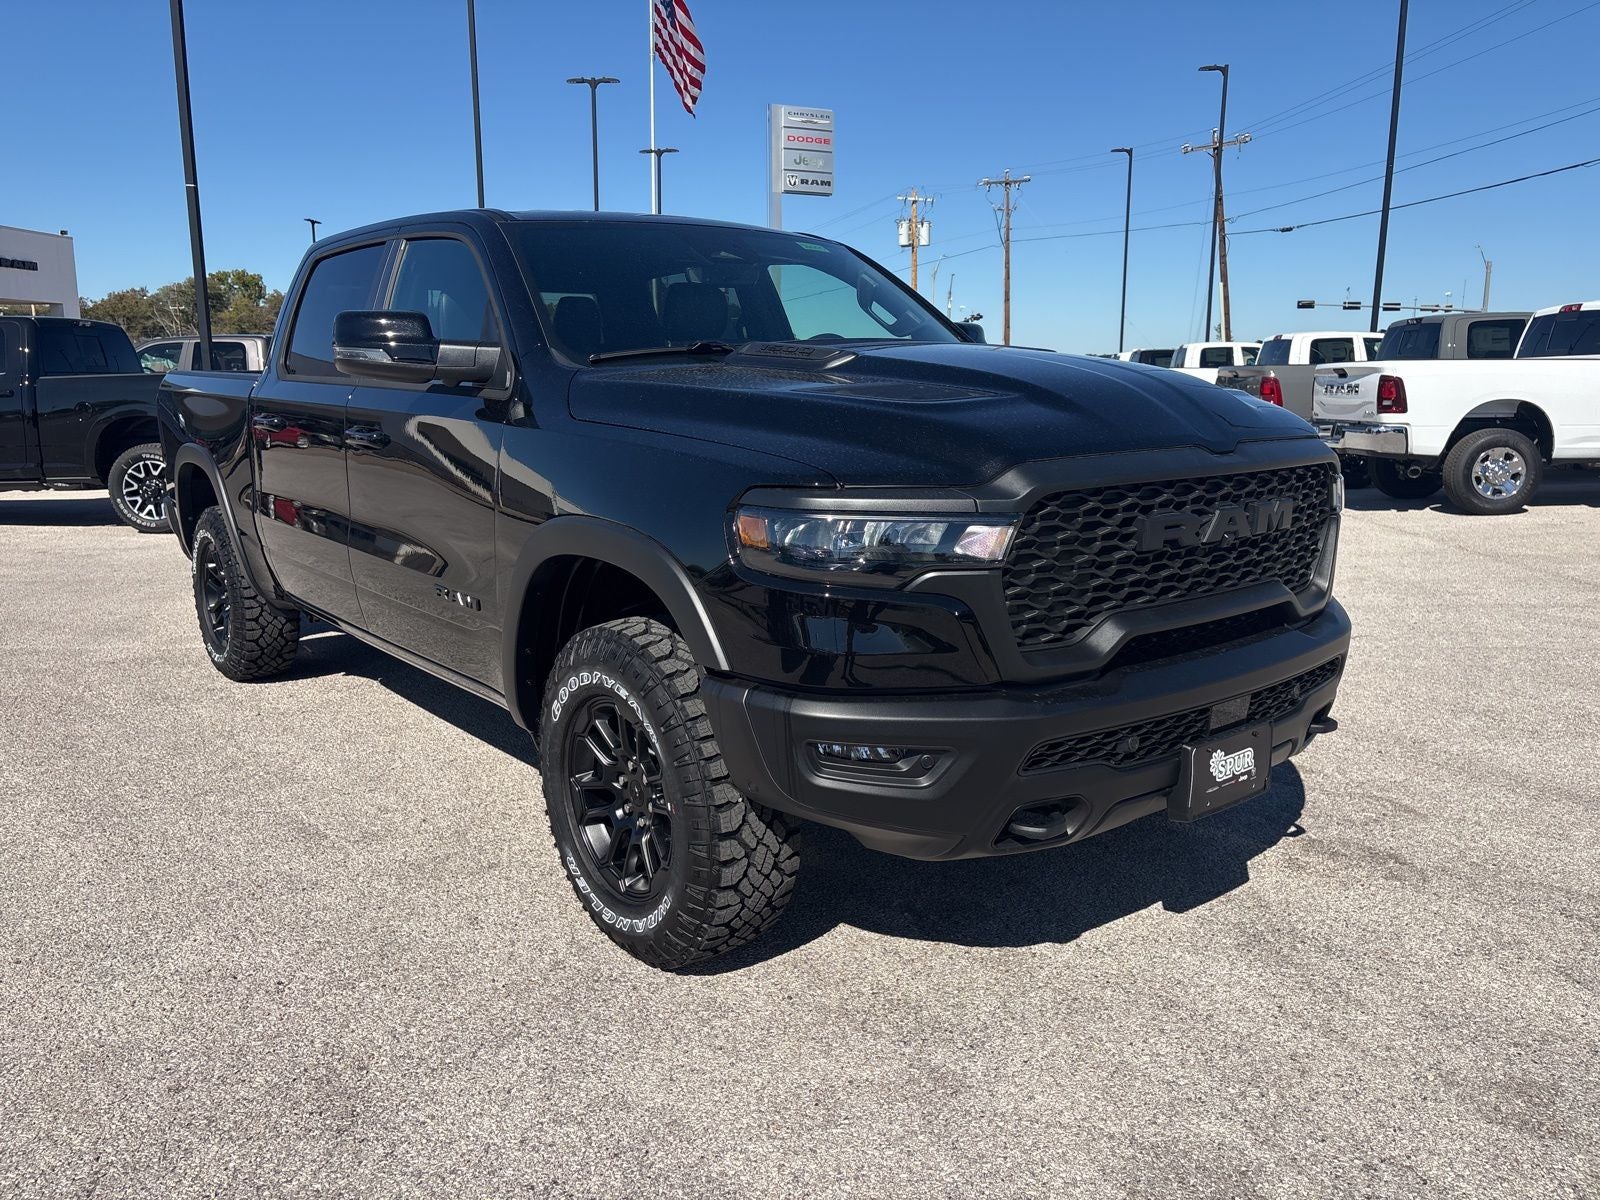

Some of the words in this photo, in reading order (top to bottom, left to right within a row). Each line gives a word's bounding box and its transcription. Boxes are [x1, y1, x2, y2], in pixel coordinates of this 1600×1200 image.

[788, 111, 830, 119] CHRYSLER
[788, 135, 830, 144] DODGE
[800, 179, 831, 187] RAM
[1323, 383, 1359, 395] RAM
[1133, 497, 1294, 551] RAM
[1218, 750, 1253, 779] SPUR
[566, 855, 672, 933] WRANGLER
